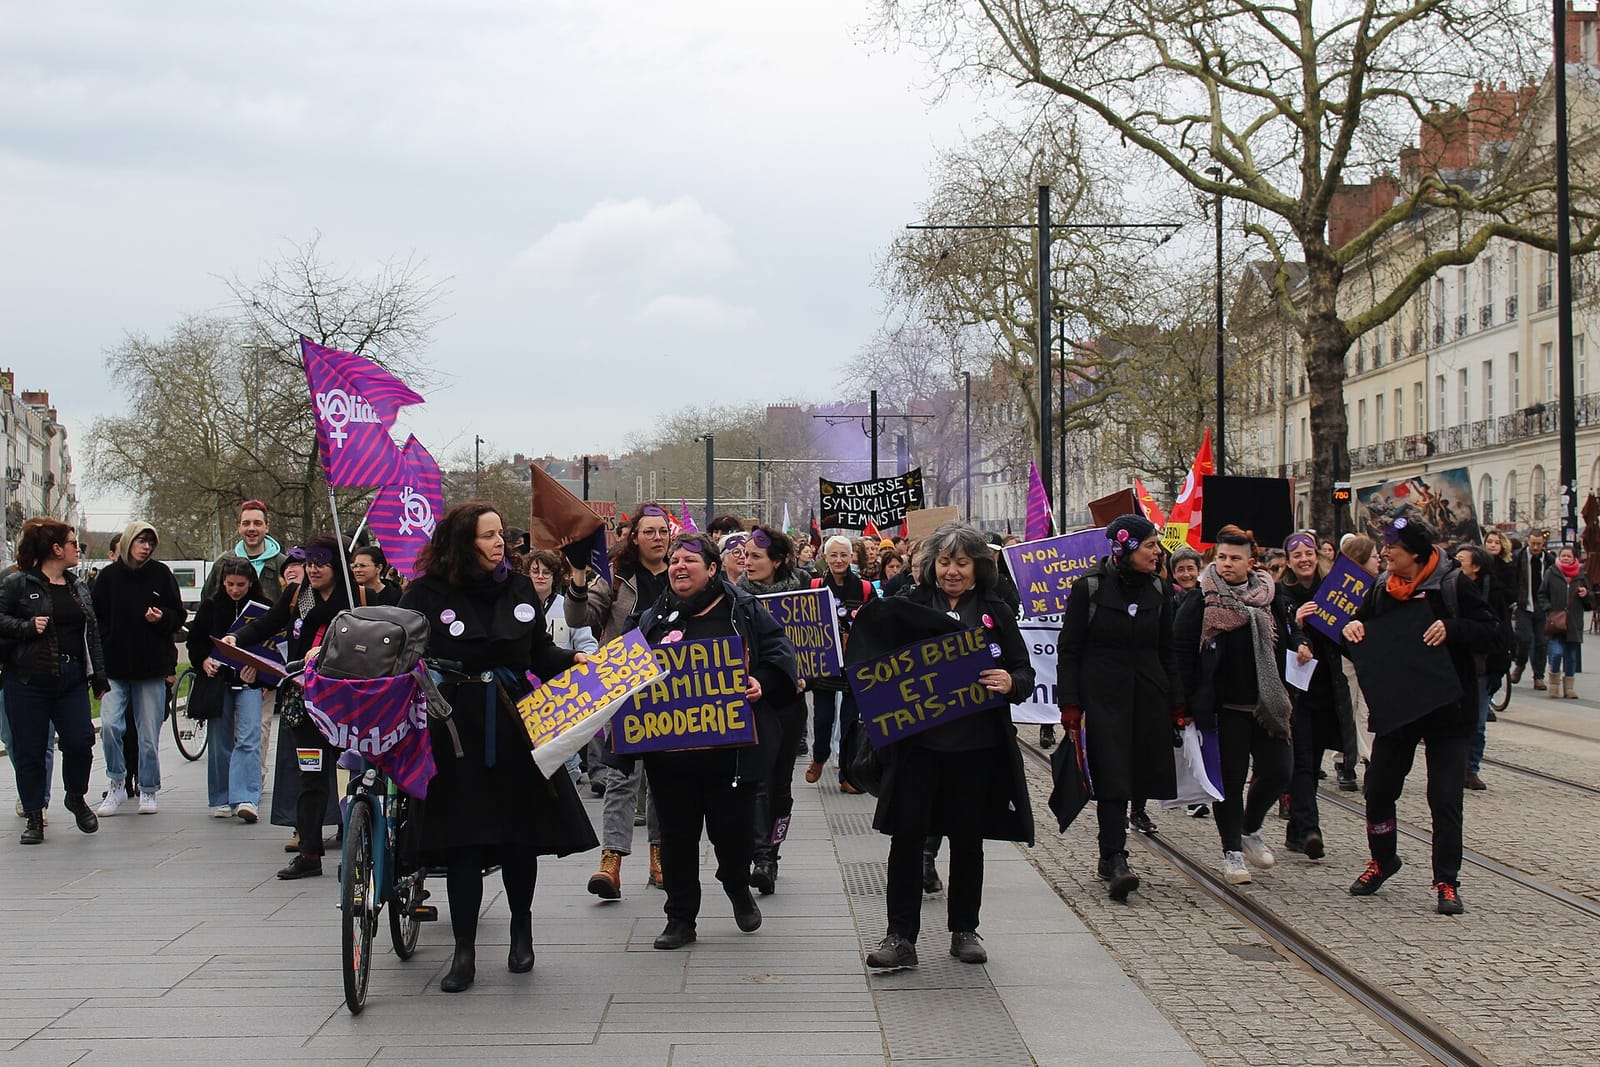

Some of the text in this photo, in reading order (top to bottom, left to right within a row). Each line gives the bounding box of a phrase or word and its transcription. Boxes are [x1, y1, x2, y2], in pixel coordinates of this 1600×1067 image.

[822, 488, 918, 513] SYNDICALISTE
[836, 477, 904, 497] JEUNESSE
[838, 506, 907, 526] FEMINISTE
[1021, 547, 1059, 565] MON
[1029, 581, 1051, 594] AU
[780, 591, 822, 624] SERAI
[1031, 598, 1048, 613] DE
[596, 642, 646, 677] PAS
[600, 651, 654, 691] MON
[856, 626, 987, 693] SOIS BELLE
[632, 671, 748, 711] FAMILLE
[899, 672, 939, 703] ET
[623, 699, 746, 745] BRODERIE
